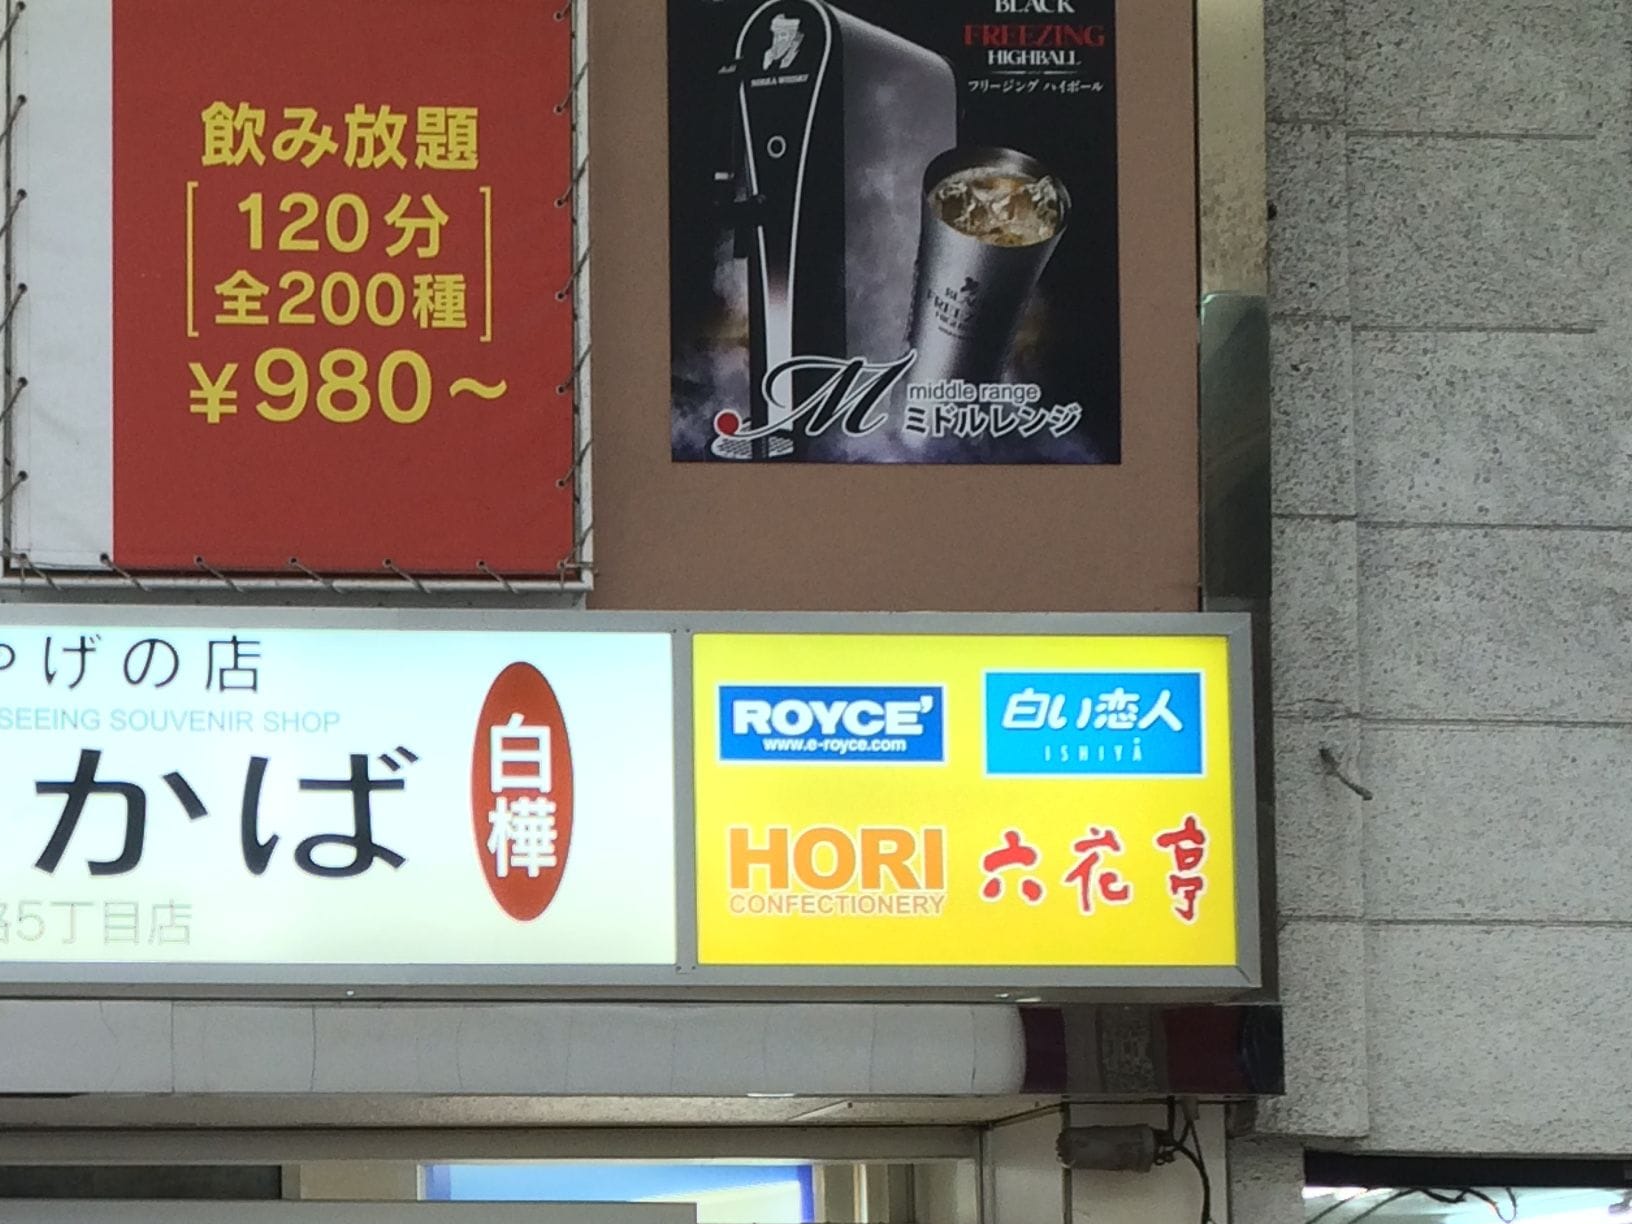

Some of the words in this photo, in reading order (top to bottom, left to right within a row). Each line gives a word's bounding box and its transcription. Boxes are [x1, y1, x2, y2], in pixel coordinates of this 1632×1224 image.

[995, 0, 1075, 13] BLACK
[963, 25, 1105, 47] FREEZING
[988, 49, 1082, 65] HIGHBALL
[201, 101, 479, 170] 飲み放題
[214, 270, 467, 329] 全200種
[908, 381, 977, 400] middle
[979, 383, 1042, 404] range
[903, 402, 1082, 439] ミドルレンジ
[109, 708, 255, 734] SOUVENIR
[263, 710, 341, 735] SHOP
[1002, 686, 1184, 732] 白い恋人
[763, 737, 907, 755] www.e-royce.com
[486, 712, 558, 878] 白樺
[729, 827, 945, 890] HORI
[982, 815, 1208, 921] 六花亭
[729, 894, 945, 915] CONFECTIONERY
